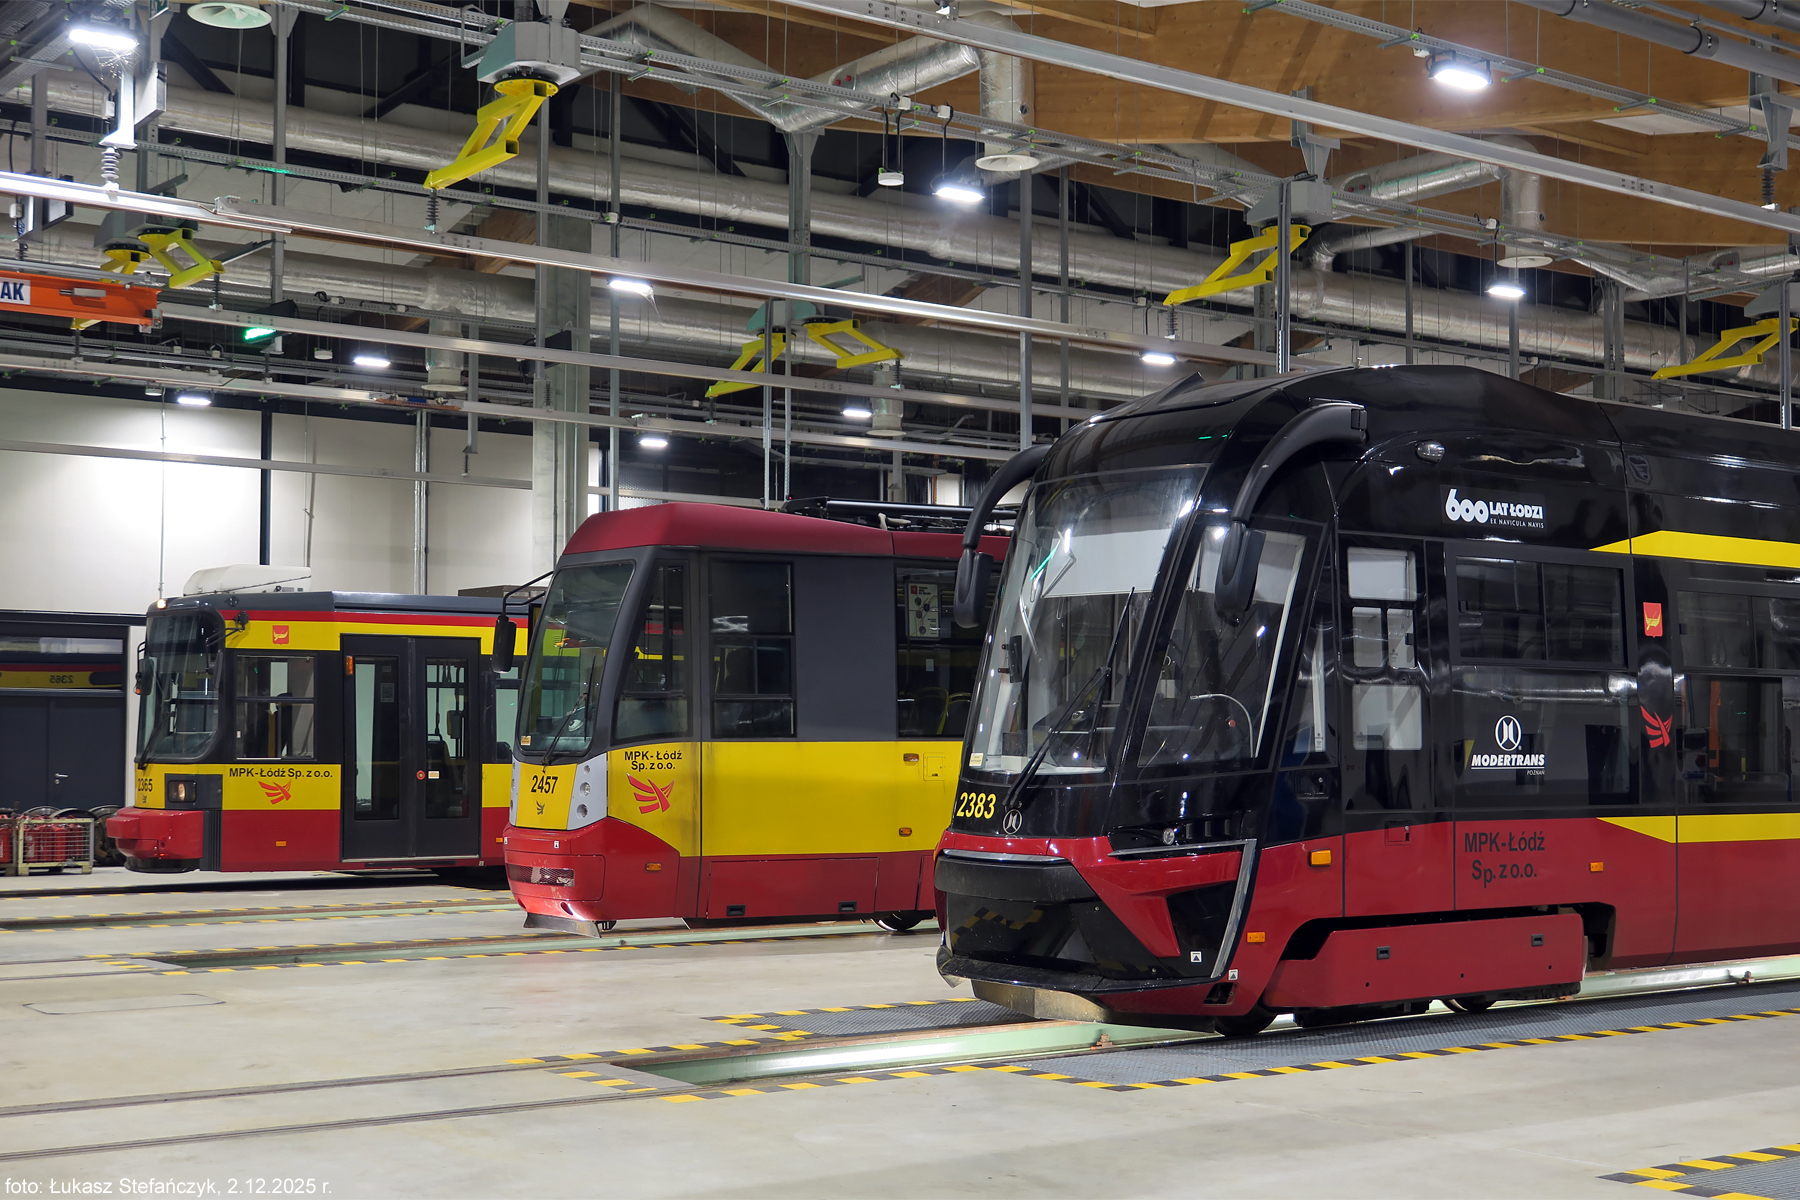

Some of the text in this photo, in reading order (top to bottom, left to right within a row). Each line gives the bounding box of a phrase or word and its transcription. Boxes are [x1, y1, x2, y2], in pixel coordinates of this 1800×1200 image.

[1445, 488, 1489, 523] 600
[1489, 501, 1544, 519] LAT ŁODZI
[1498, 518, 1526, 527] NAVICULA
[1527, 521, 1544, 529] NAVIS
[624, 750, 682, 761] MPK-Łódź
[1471, 754, 1545, 767] MODERTRANS
[229, 767, 286, 778] MPK-Łódź
[287, 768, 304, 779] Sp.
[314, 770, 333, 778] o.o.
[631, 761, 676, 772] Sp. z o.o.
[531, 775, 559, 794] 2457
[956, 791, 997, 819] 2383
[1464, 830, 1546, 853] MPK-Łódź
[1471, 859, 1537, 889] Sp. z o.o.
